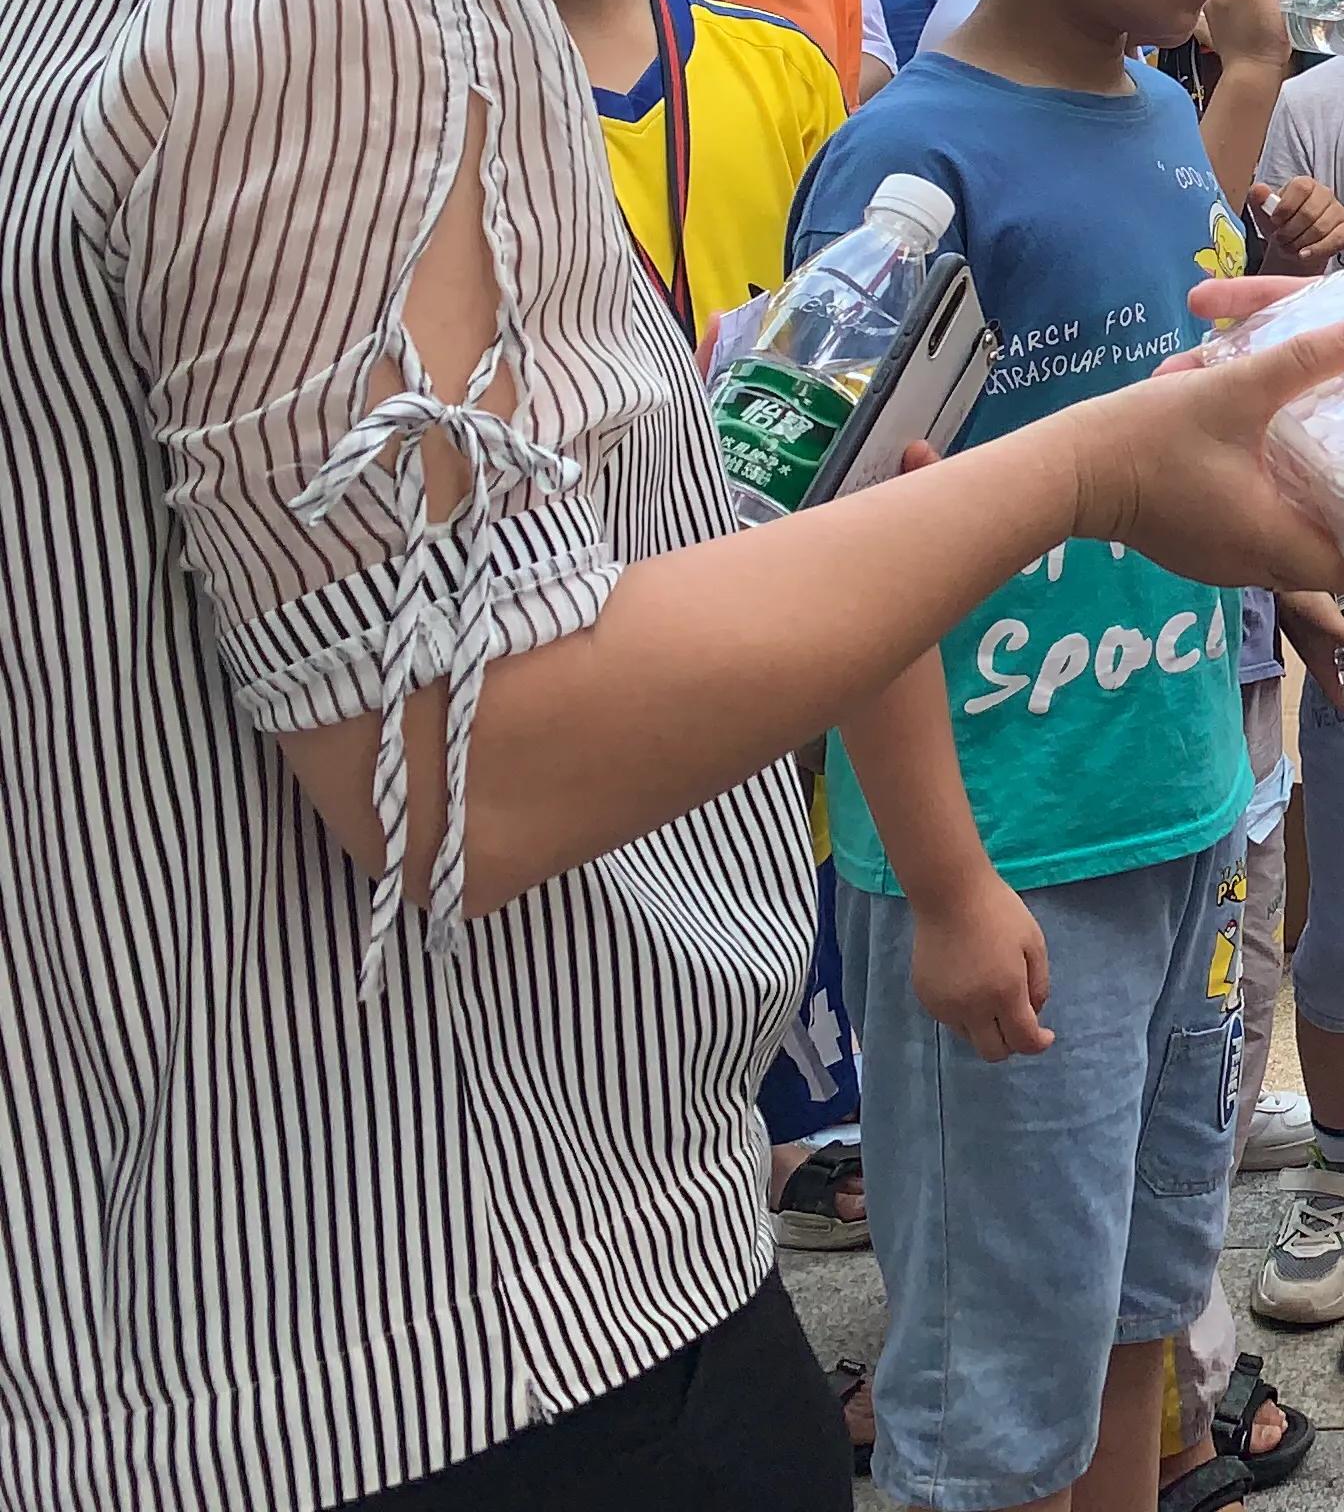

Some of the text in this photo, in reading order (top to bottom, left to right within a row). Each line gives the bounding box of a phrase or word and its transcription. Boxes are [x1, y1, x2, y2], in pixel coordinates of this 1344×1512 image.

[996, 302, 1147, 361] EARCH FOR
[1112, 327, 1181, 364] PLANETS
